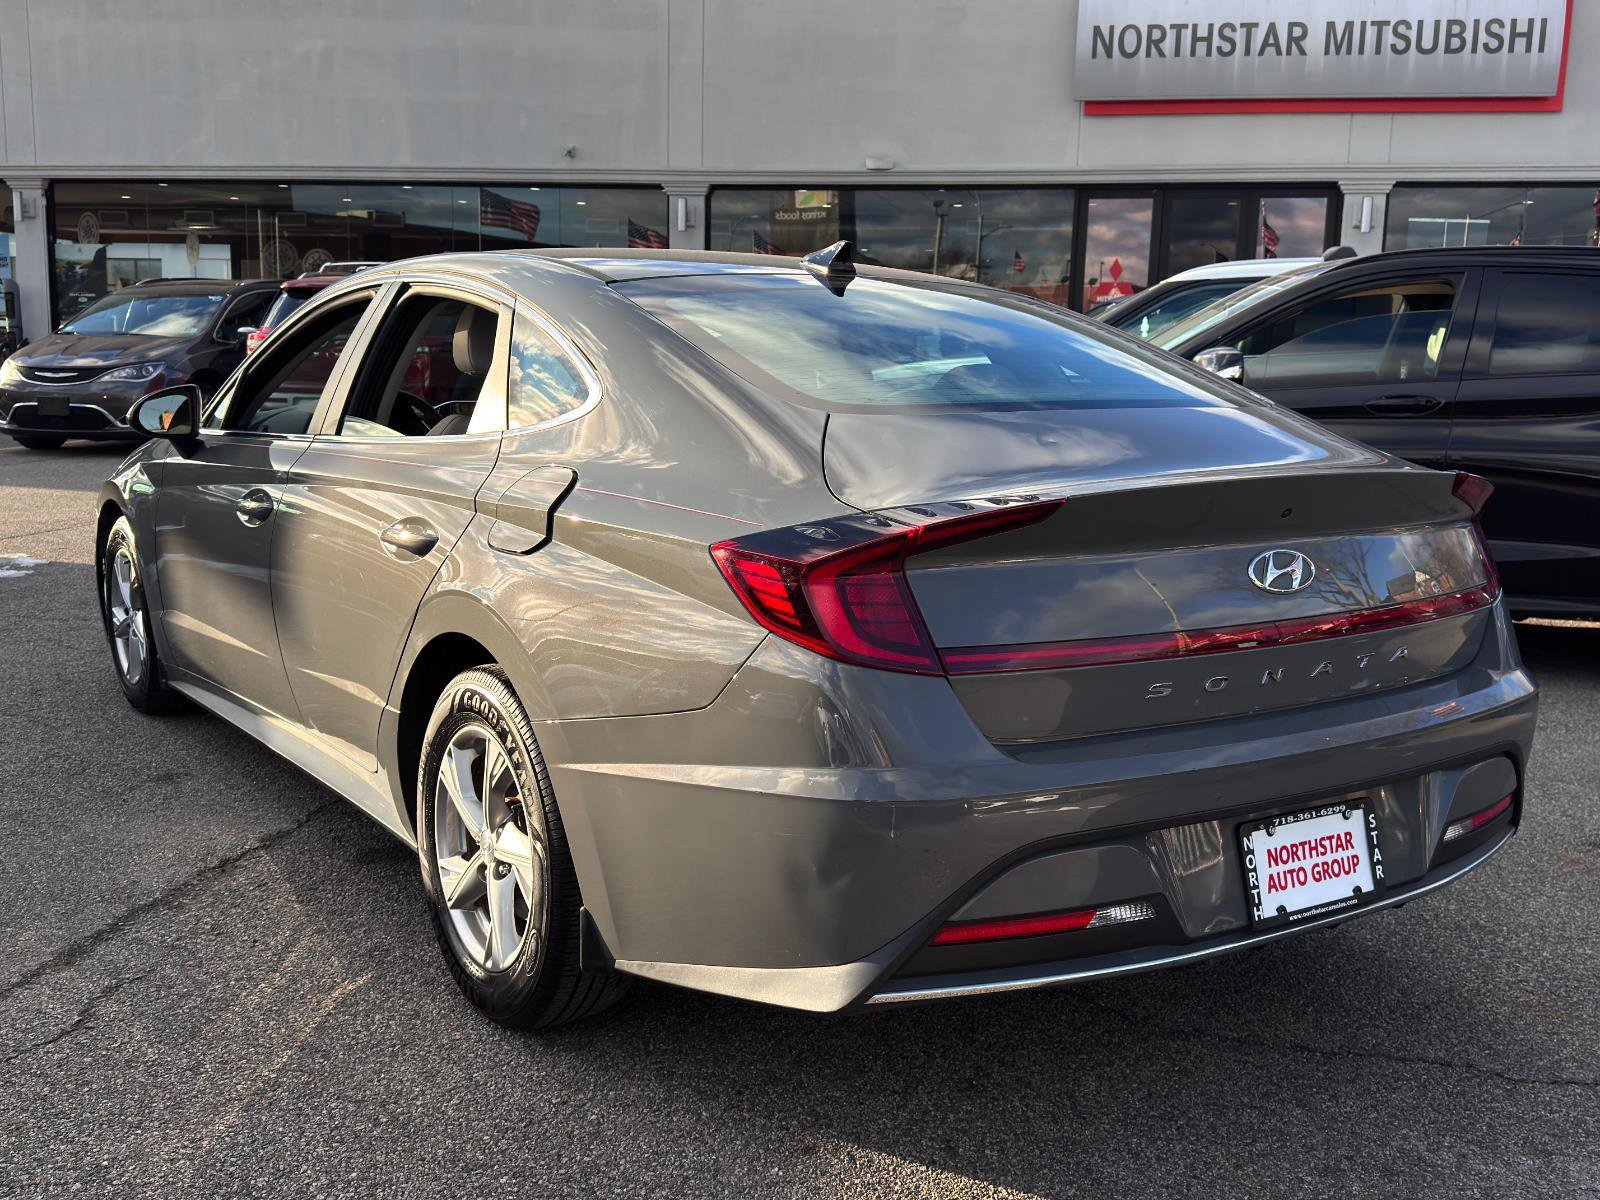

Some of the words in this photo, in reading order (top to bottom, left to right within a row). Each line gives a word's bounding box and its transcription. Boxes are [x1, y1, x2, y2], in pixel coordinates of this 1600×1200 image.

[1092, 23, 1307, 59] NORTHSTAR
[1323, 17, 1548, 56] MITSUBISHI
[1144, 646, 1410, 699] SONATA
[463, 691, 535, 807] GOODYEAR
[1273, 804, 1346, 827] 718-361-6299
[1266, 831, 1355, 868] NORTHSTAR
[1368, 813, 1385, 880] STAR
[1242, 836, 1265, 922] NORTH
[1267, 866, 1308, 895] AUTO
[1311, 854, 1360, 883] GROUP
